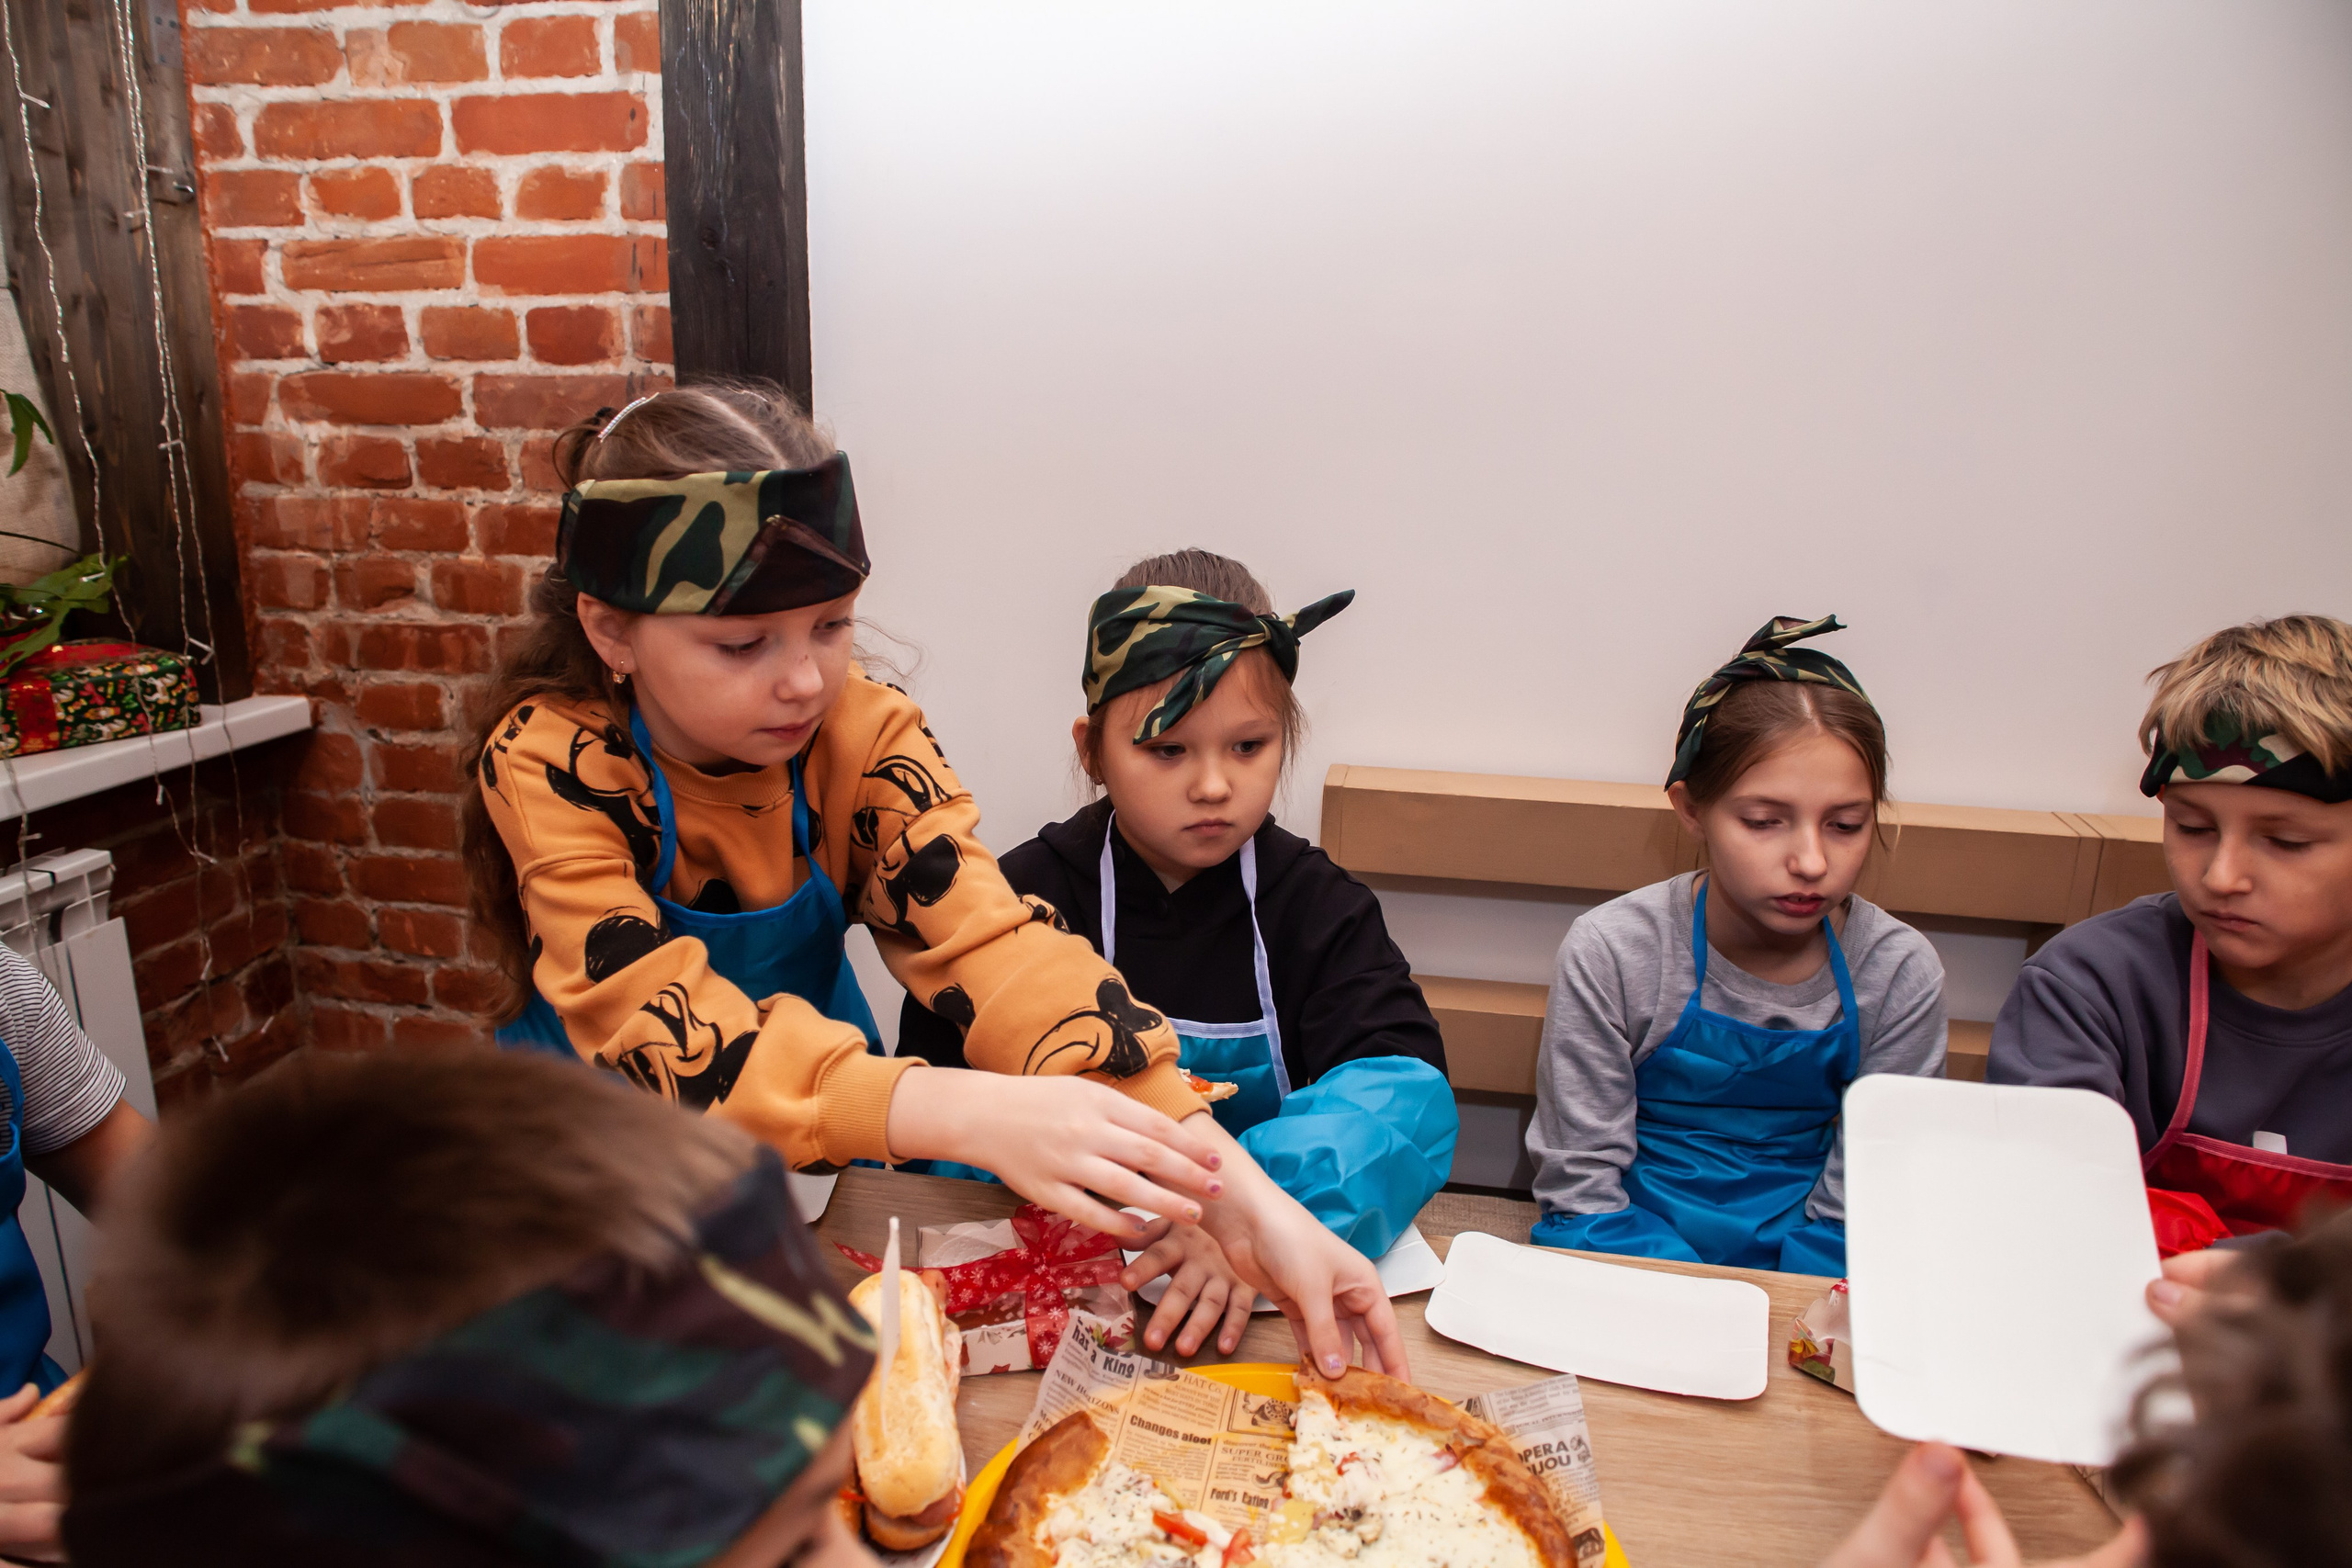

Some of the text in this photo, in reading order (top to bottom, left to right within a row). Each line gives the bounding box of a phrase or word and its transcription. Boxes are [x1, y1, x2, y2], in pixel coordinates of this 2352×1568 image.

[1071, 1325, 1090, 1351] has
[1090, 1349, 1097, 1364] a
[1102, 1356, 1135, 1379] King
[1056, 1369, 1074, 1387] NEW
[1183, 1374, 1207, 1389] HAT
[1129, 1415, 1213, 1446] Changes afoot
[1221, 1447, 1262, 1459] SUPER
[1209, 1488, 1238, 1503] Ford's
